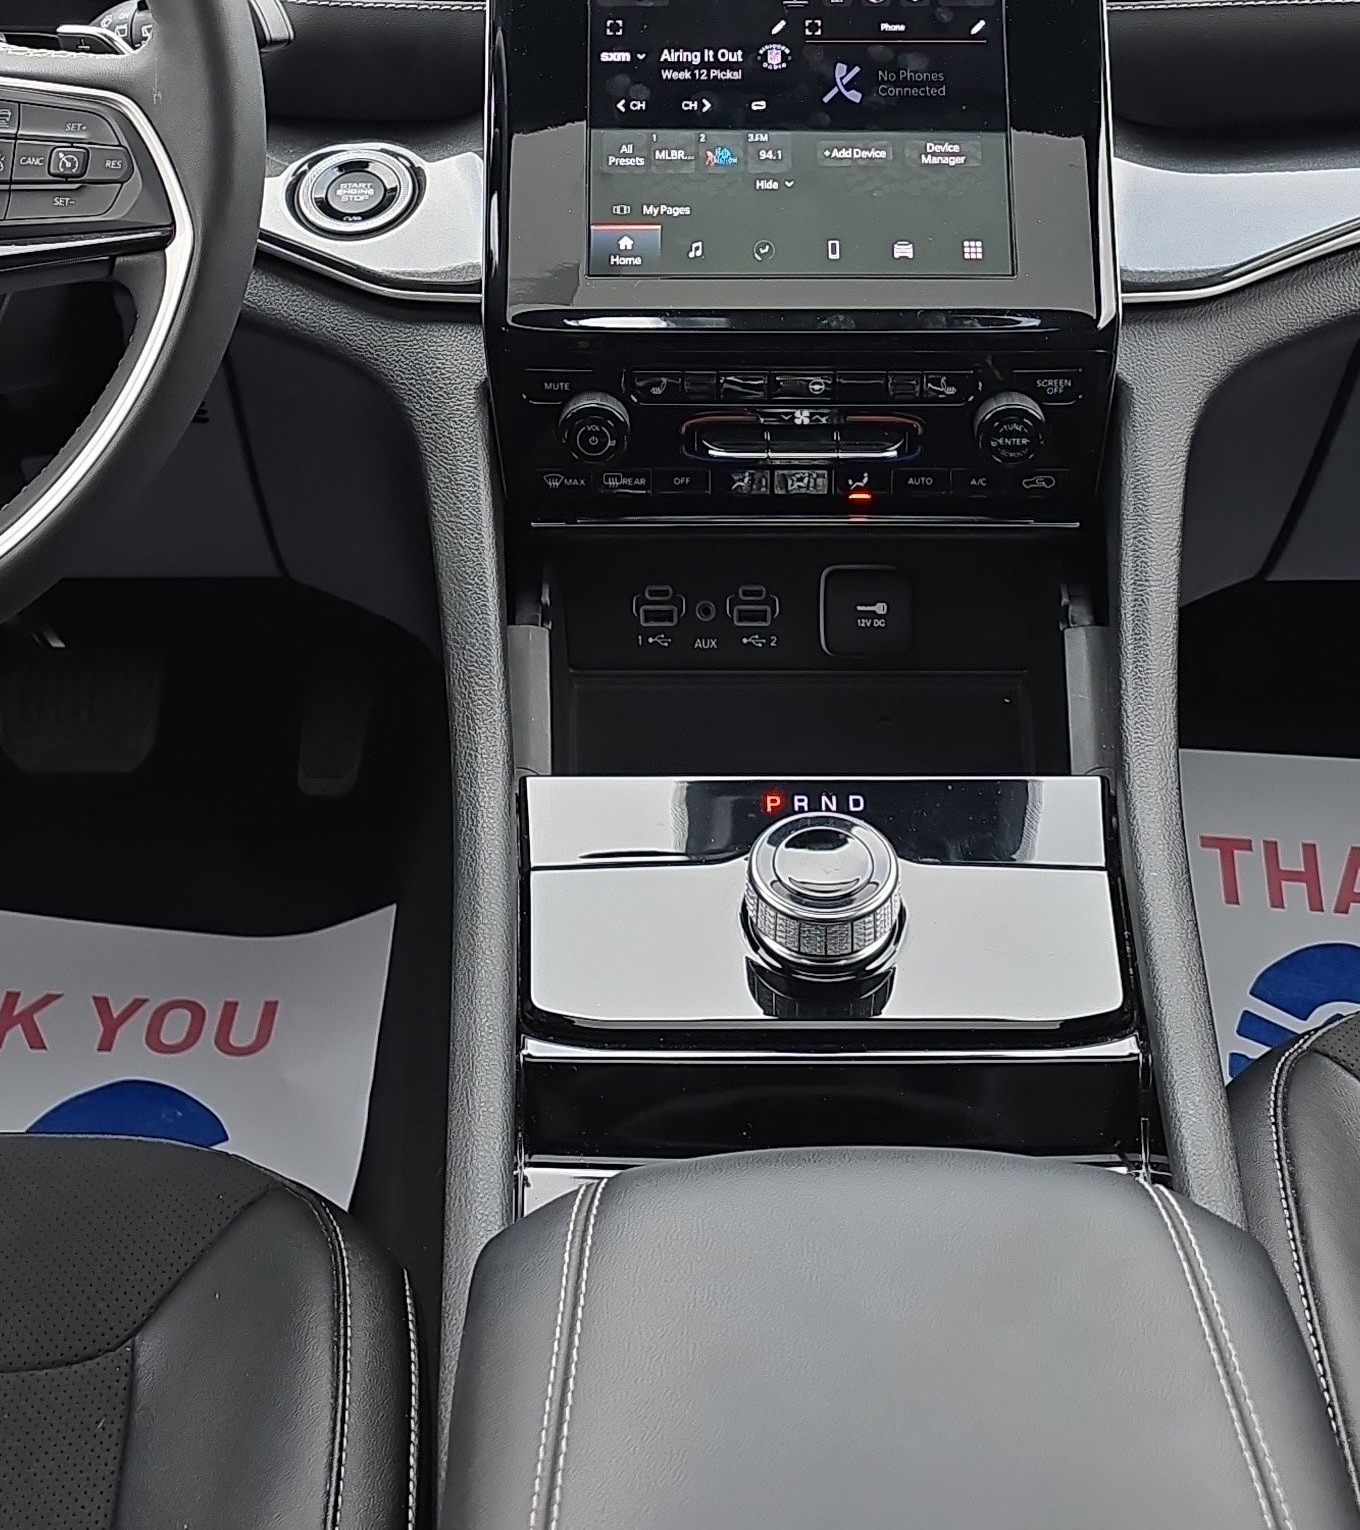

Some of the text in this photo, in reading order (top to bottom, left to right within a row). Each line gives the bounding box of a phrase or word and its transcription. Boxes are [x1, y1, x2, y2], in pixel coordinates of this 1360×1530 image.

[880, 22, 905, 32] Phone
[660, 48, 743, 65] Airing It Out
[661, 69, 742, 80] Week 12 Picks!
[878, 69, 944, 81] No Phones
[878, 85, 946, 97] Connected
[629, 101, 646, 111] CH
[681, 101, 698, 111] CH
[699, 133, 706, 142] 2
[620, 144, 633, 154] All
[926, 143, 960, 153] Device
[759, 149, 782, 160] 94.1
[853, 149, 887, 158] Device
[20, 156, 44, 166] CANC
[105, 160, 122, 169] RES
[608, 156, 645, 166] Presets
[921, 154, 966, 166] Manager
[756, 180, 778, 189] Hide
[642, 205, 691, 218] My Pages
[610, 255, 642, 266] Home
[544, 382, 571, 391] MUTE
[1036, 379, 1072, 388] SCREEN
[1046, 387, 1064, 395] OFF
[586, 424, 601, 432] VOL
[999, 437, 1027, 446] ENTER
[564, 478, 586, 486] MAX
[622, 477, 646, 486] REAR
[673, 477, 690, 486] OFF
[907, 477, 933, 486] AUTO
[970, 477, 988, 487] A/C
[857, 619, 886, 628] 12V DC
[638, 636, 643, 646] 1
[694, 638, 718, 650] AUX
[770, 636, 777, 647] 2
[766, 796, 865, 812] P R N D
[91, 994, 280, 1058] YOU
